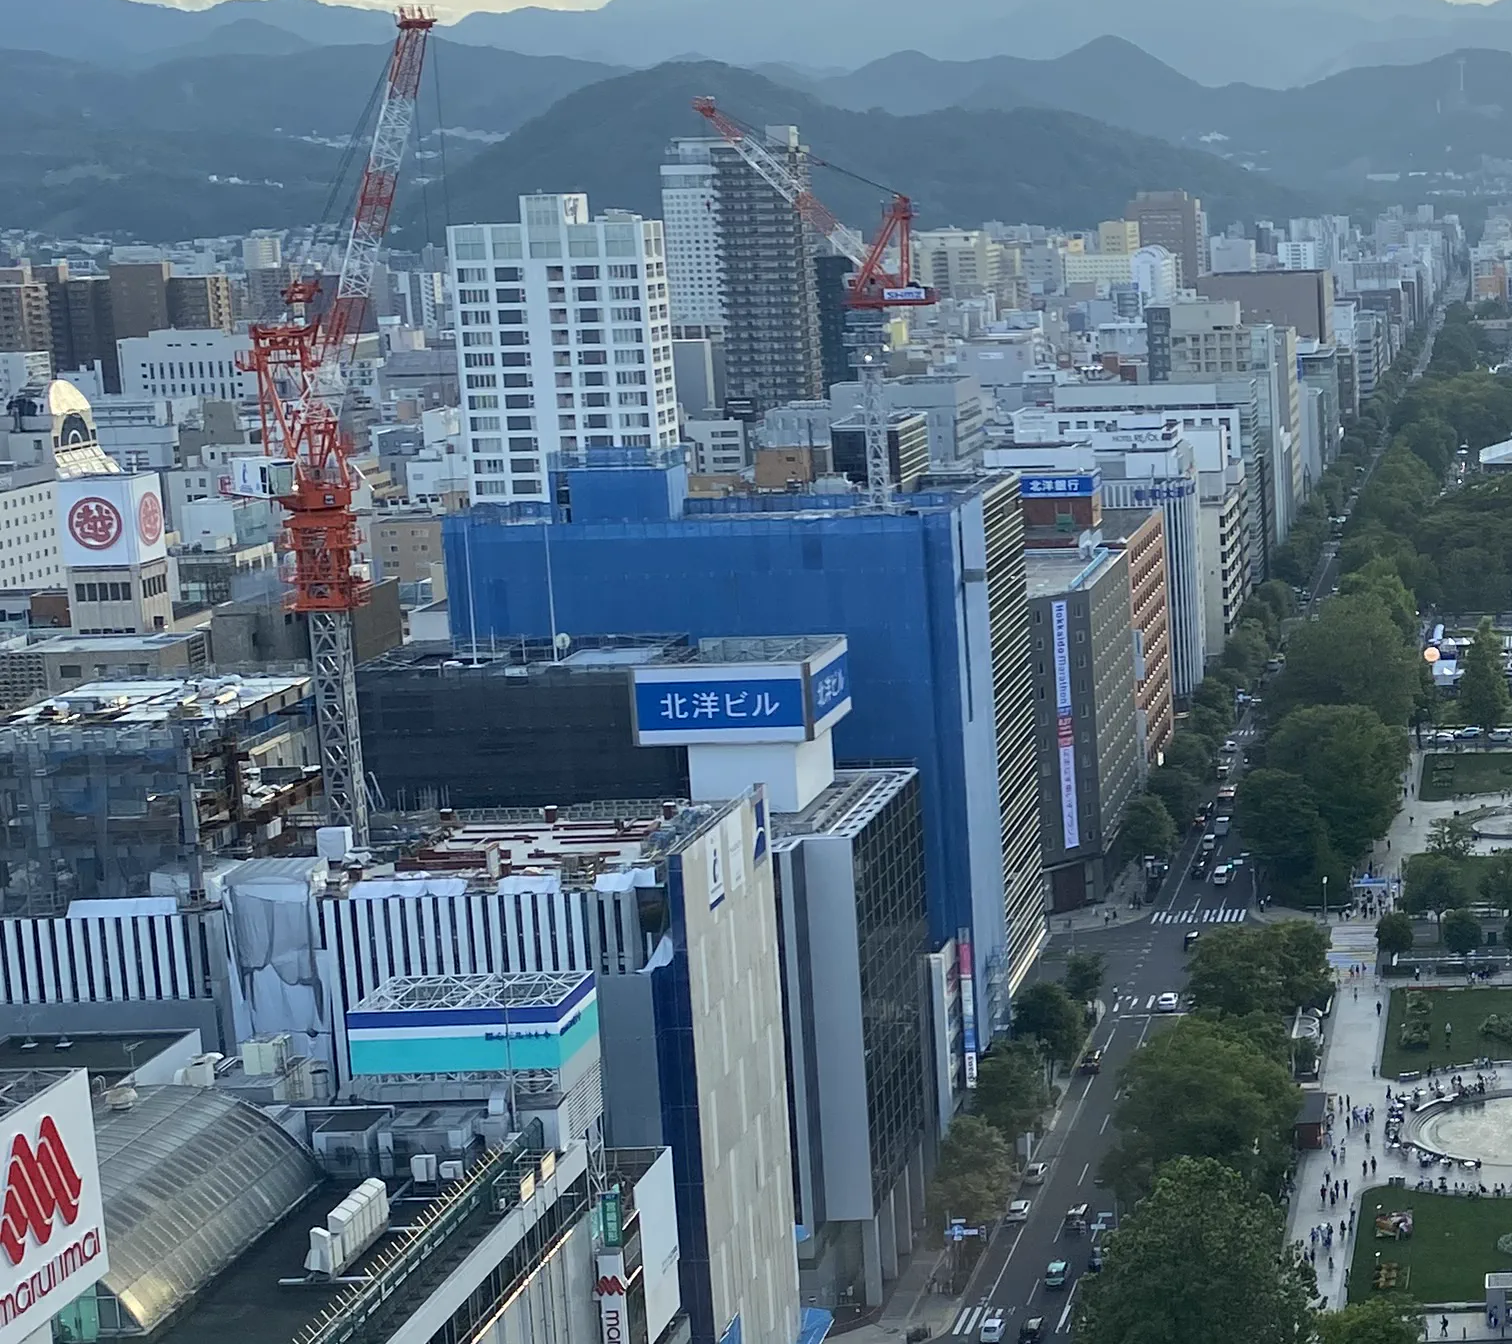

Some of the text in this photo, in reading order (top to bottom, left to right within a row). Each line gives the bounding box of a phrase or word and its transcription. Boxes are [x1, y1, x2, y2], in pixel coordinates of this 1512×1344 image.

[1030, 479, 1080, 492] 北洋銀行
[1055, 604, 1067, 654] Hokkaido
[1059, 655, 1070, 704] Marathon
[660, 692, 780, 719] 北洋ビル
